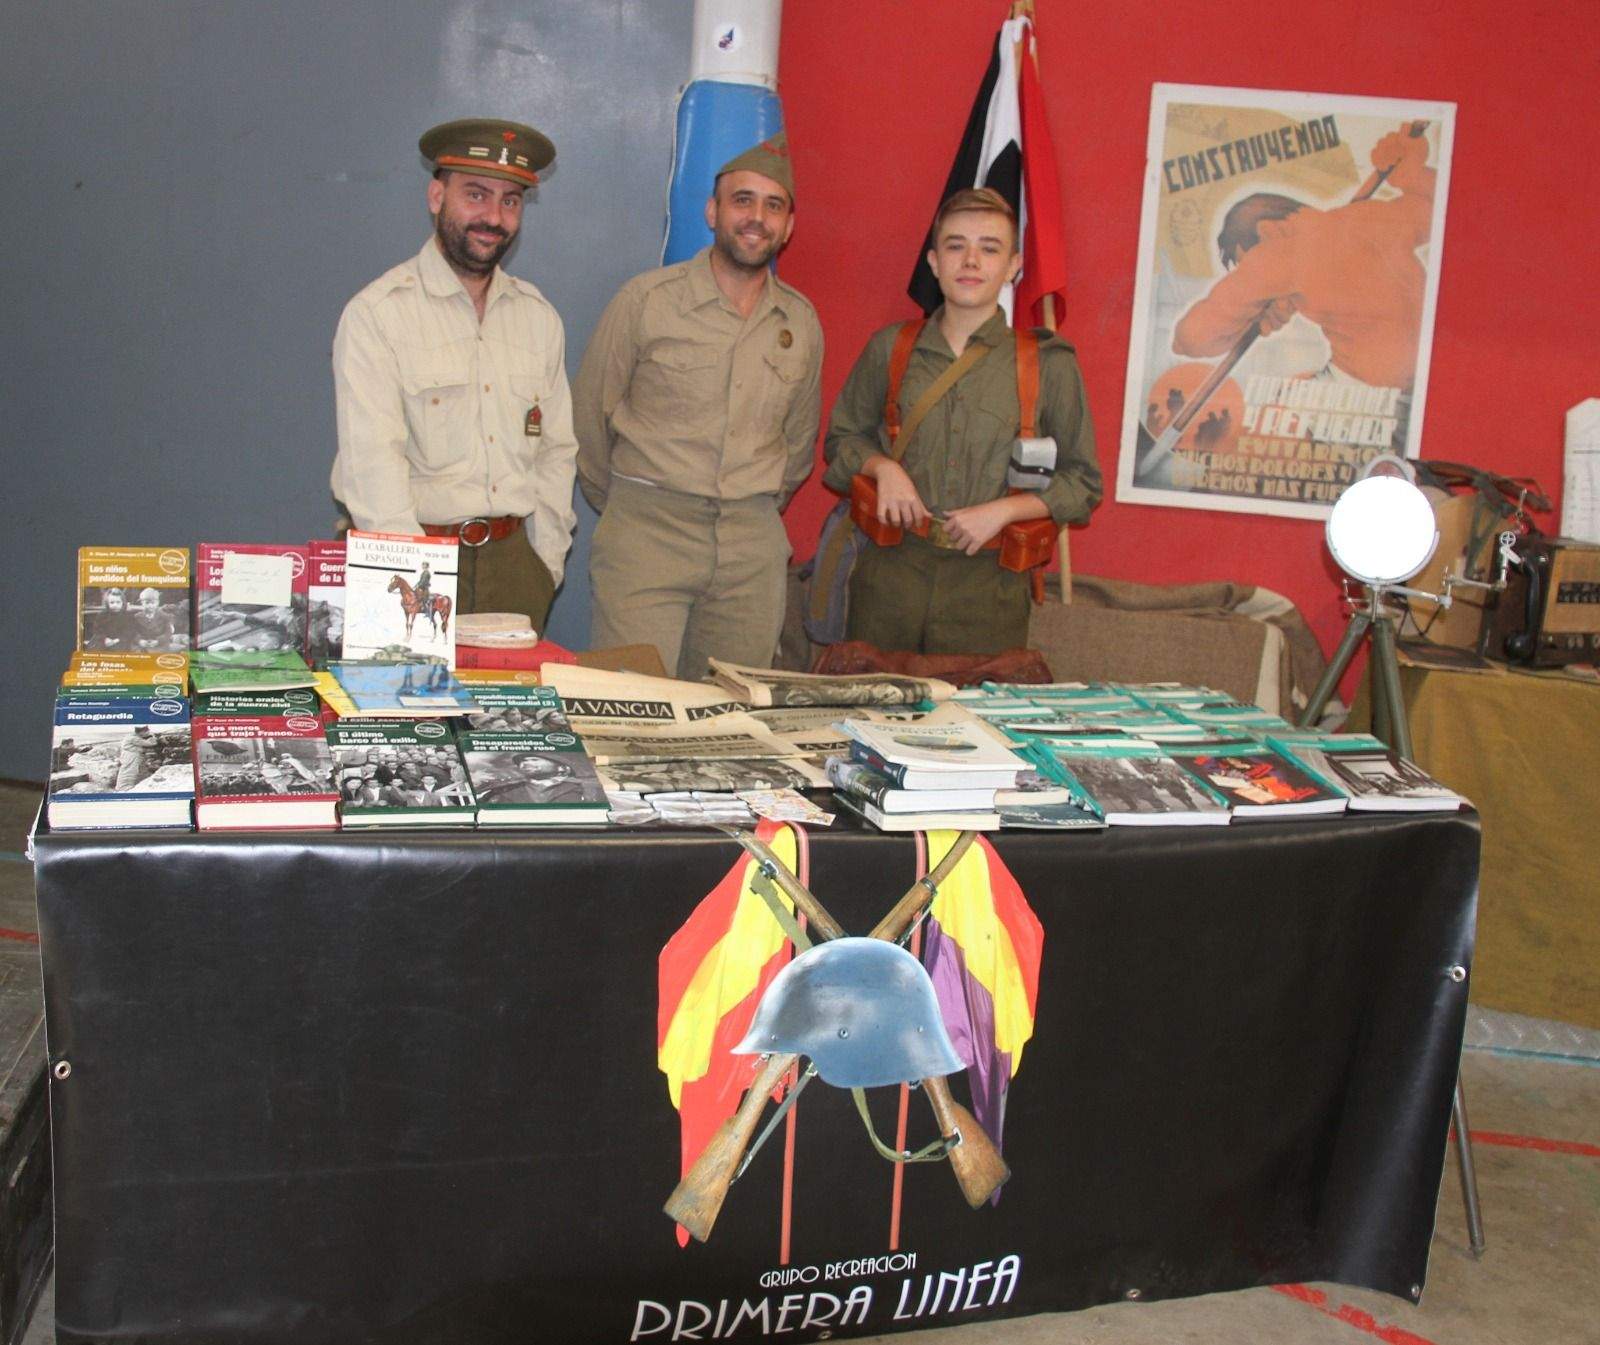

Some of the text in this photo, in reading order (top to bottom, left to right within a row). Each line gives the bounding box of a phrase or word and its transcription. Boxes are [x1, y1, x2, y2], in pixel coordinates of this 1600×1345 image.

[1163, 114, 1340, 193] CONSTRUYENDO
[1250, 458, 1336, 481] DOLORES
[1262, 478, 1301, 499] MAS
[89, 564, 129, 574] Los niños
[320, 573, 342, 582] de la
[89, 574, 187, 585] perdidos del franquismo
[67, 712, 134, 721] Retaguardia
[562, 699, 673, 717] LA VANGUA
[230, 730, 255, 738] trajo
[759, 1252, 918, 1288] GRUPO RECREACION
[629, 1254, 1022, 1343] PRIMERA LINEA
